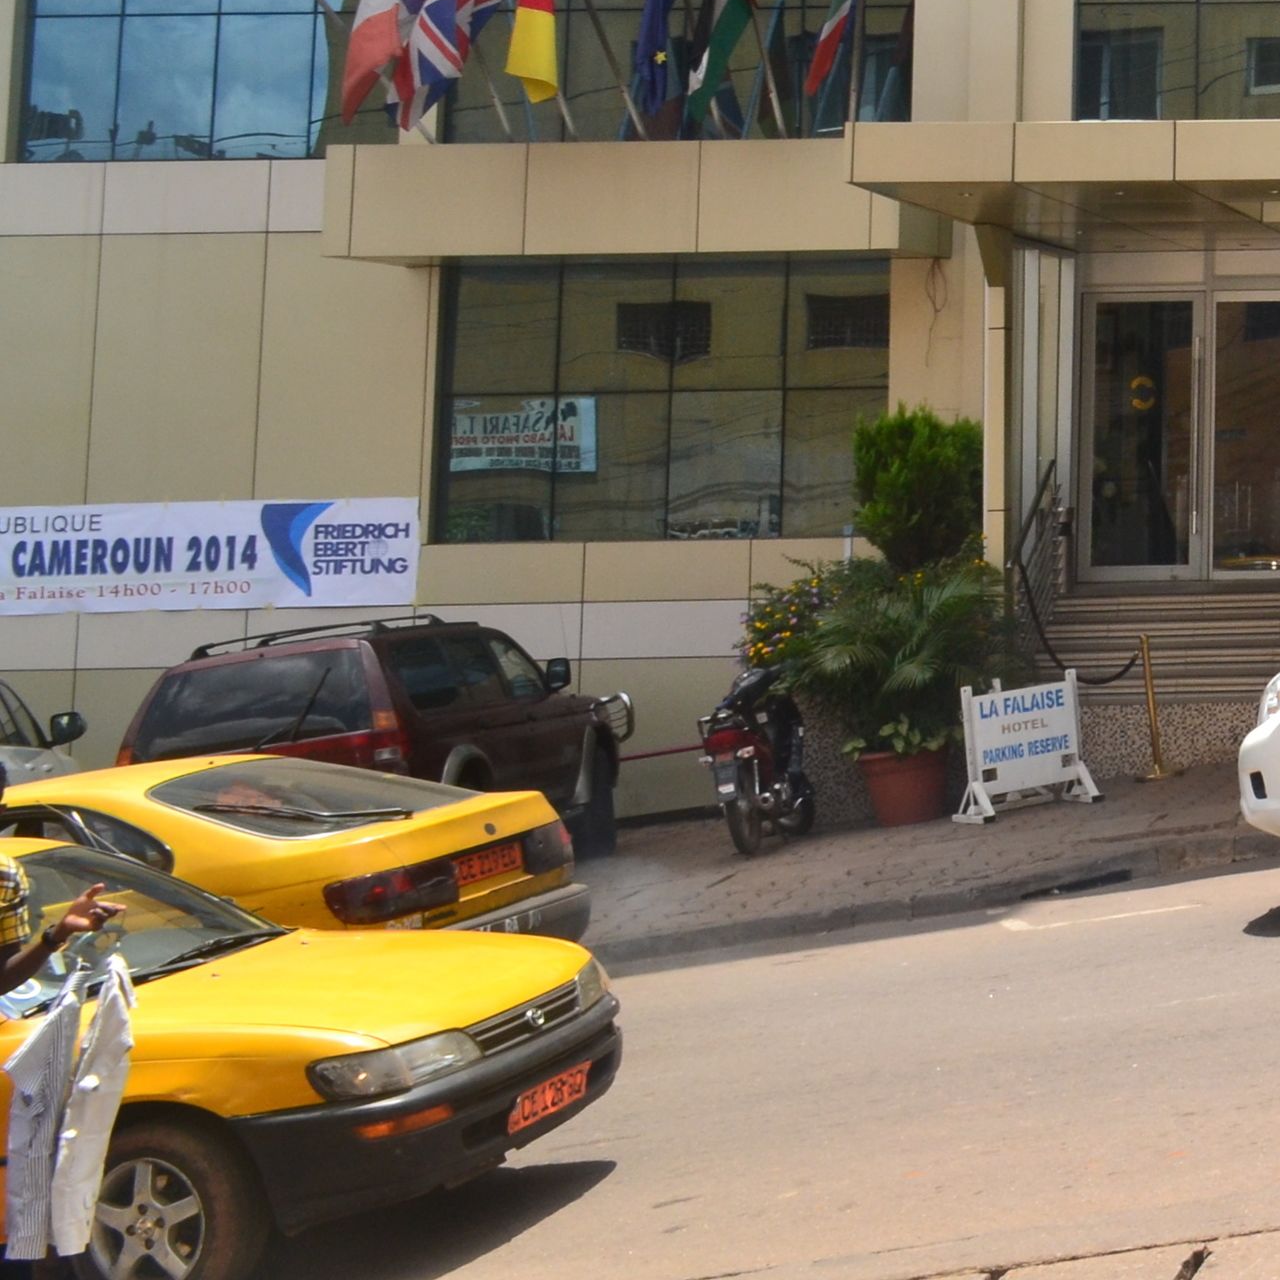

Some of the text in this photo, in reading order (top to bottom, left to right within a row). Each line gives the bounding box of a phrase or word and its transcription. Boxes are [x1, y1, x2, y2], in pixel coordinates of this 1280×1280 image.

[314, 523, 410, 539] FRIEDRICH
[12, 535, 258, 577] CAMEROUN 2014
[314, 540, 369, 557] EBERT
[312, 557, 408, 575] STIFTUNG
[16, 586, 85, 600] Falaise
[97, 583, 162, 597] 14h00
[189, 581, 251, 595] 17h00
[979, 688, 1065, 720] LA FALAISE
[1002, 718, 1049, 734] HOTEL
[983, 734, 1070, 765] PARKING RESERVE
